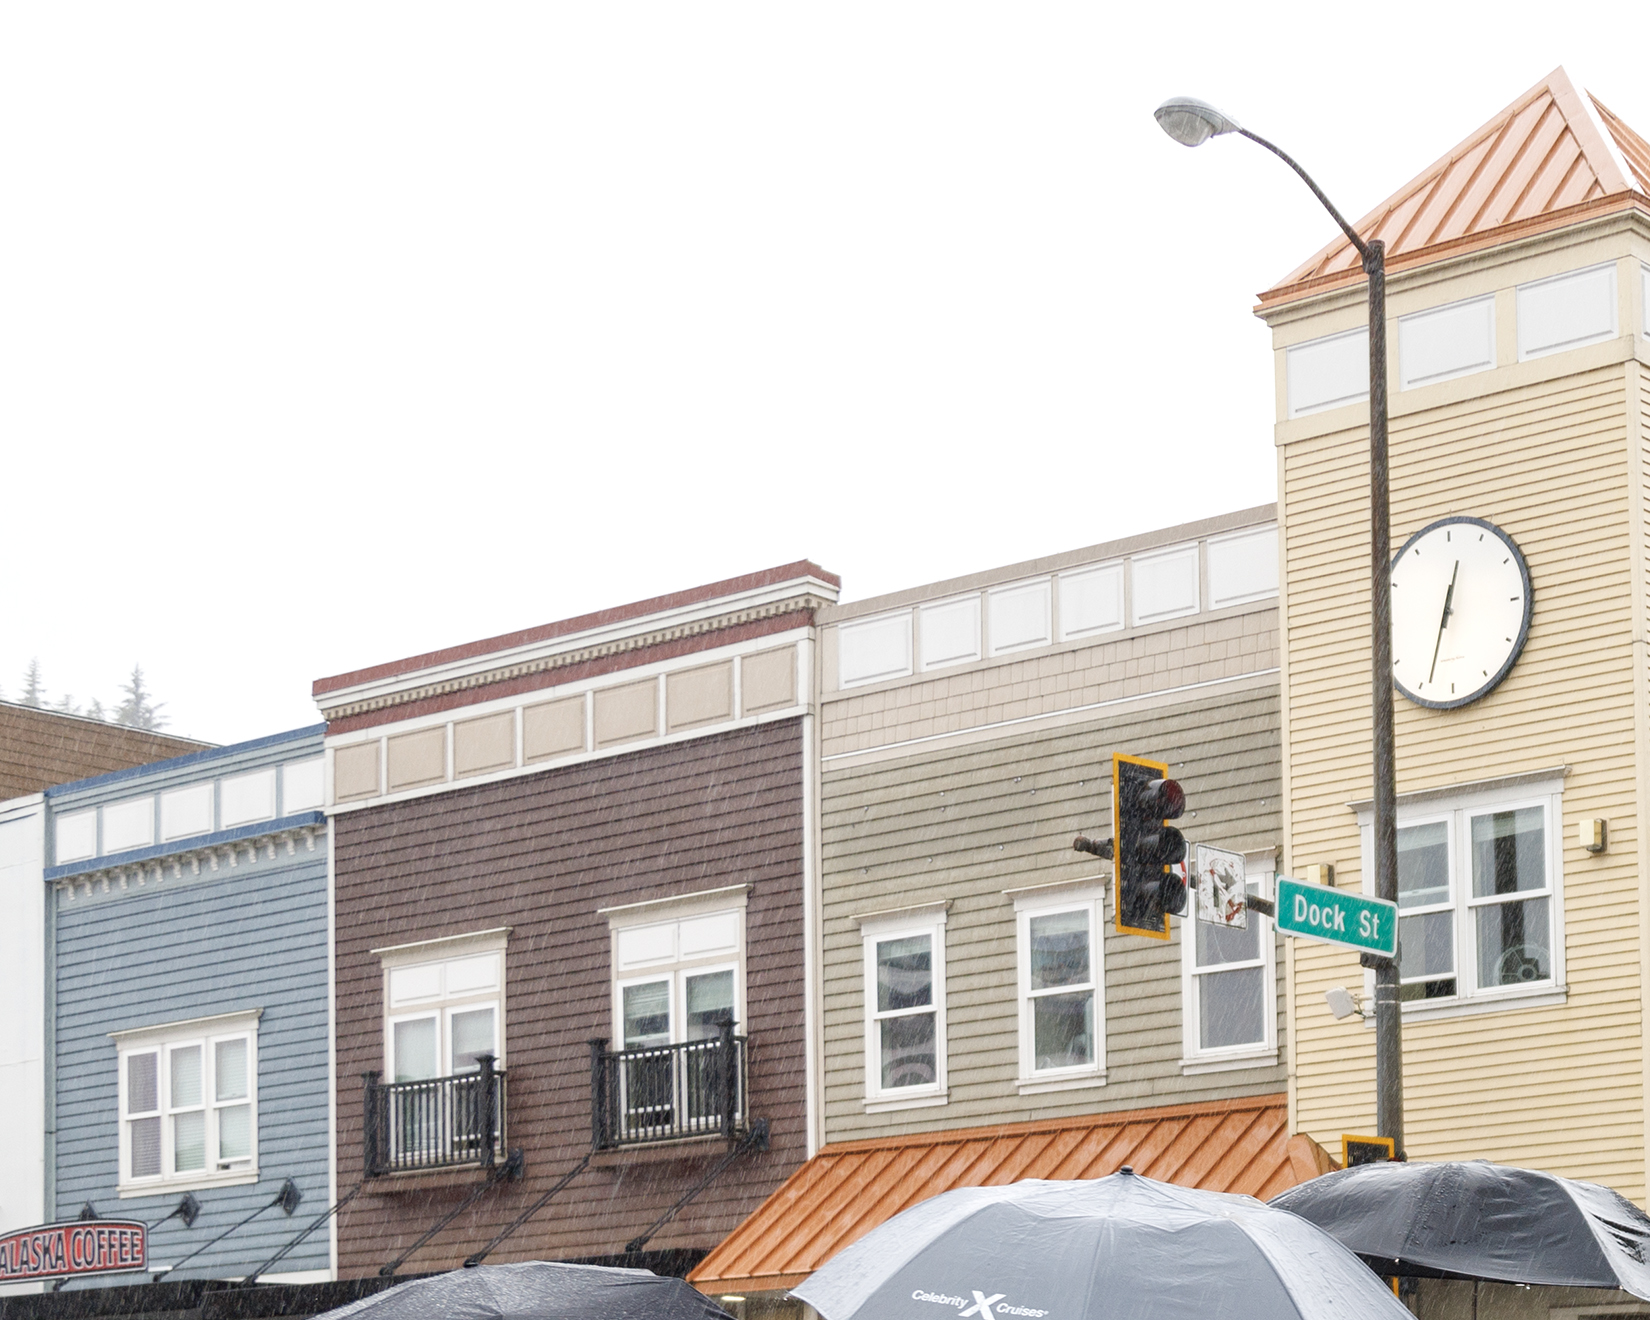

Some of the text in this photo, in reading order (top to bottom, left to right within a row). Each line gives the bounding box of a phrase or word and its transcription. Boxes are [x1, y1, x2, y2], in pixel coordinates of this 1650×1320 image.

[1295, 894, 1380, 939] Dock St
[0, 1228, 143, 1276] ALASKA COFFEE
[911, 1289, 969, 1309] Celebrity
